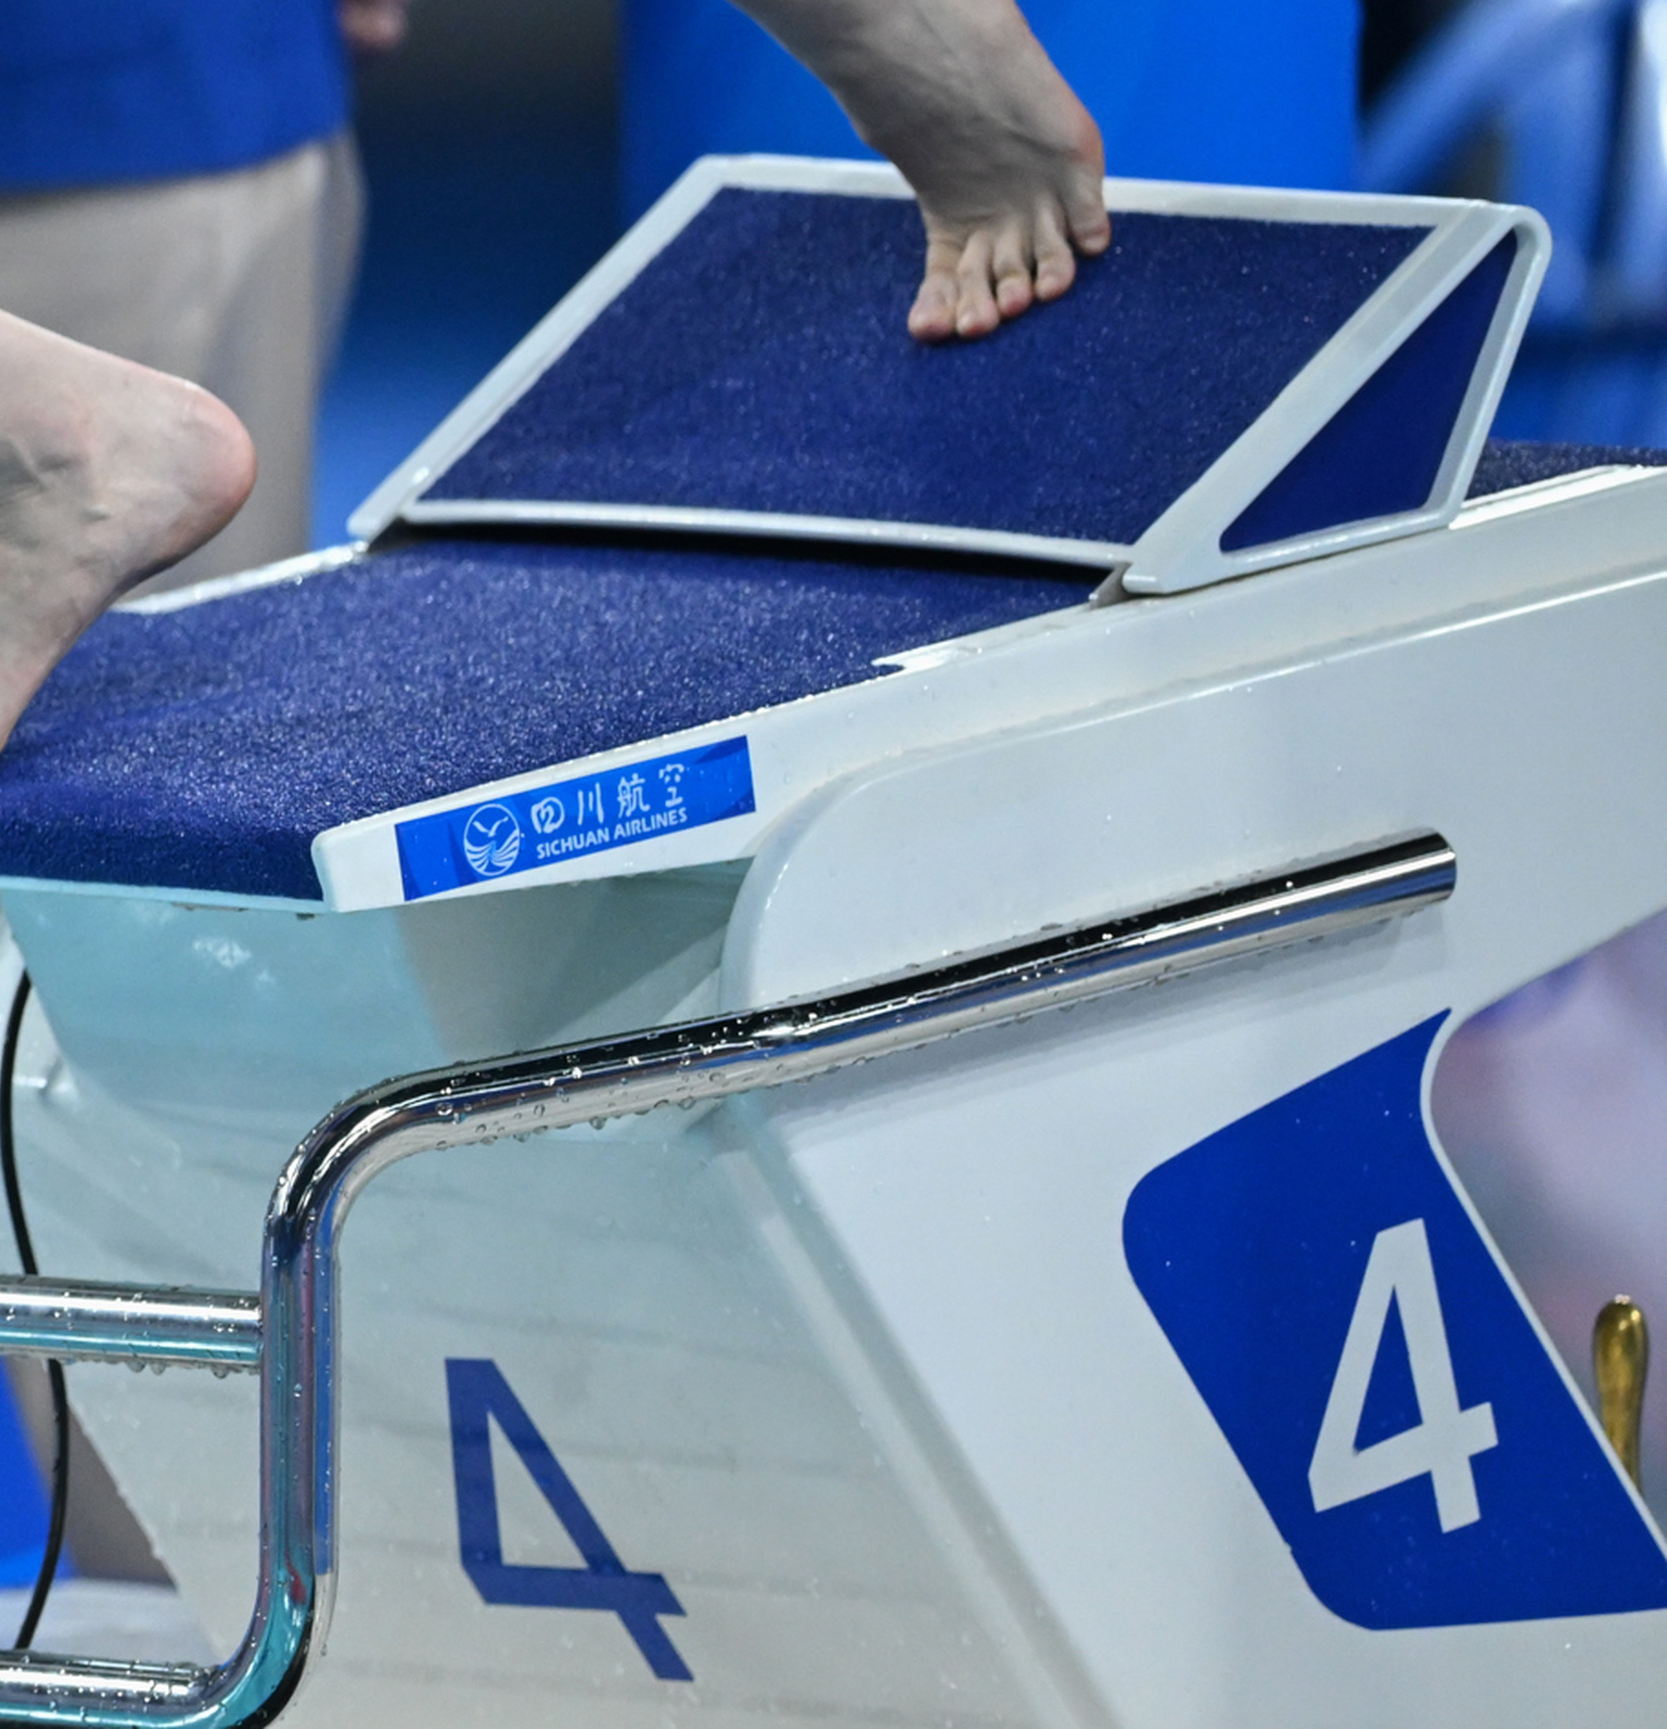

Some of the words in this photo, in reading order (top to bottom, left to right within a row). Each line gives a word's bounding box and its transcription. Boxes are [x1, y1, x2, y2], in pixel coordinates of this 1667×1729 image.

[531, 764, 684, 834] 四川航空
[537, 827, 610, 859] SICHUAN
[614, 807, 687, 839] AIRLINES
[1308, 1218, 1499, 1533] 4
[444, 1357, 694, 1681] 4
